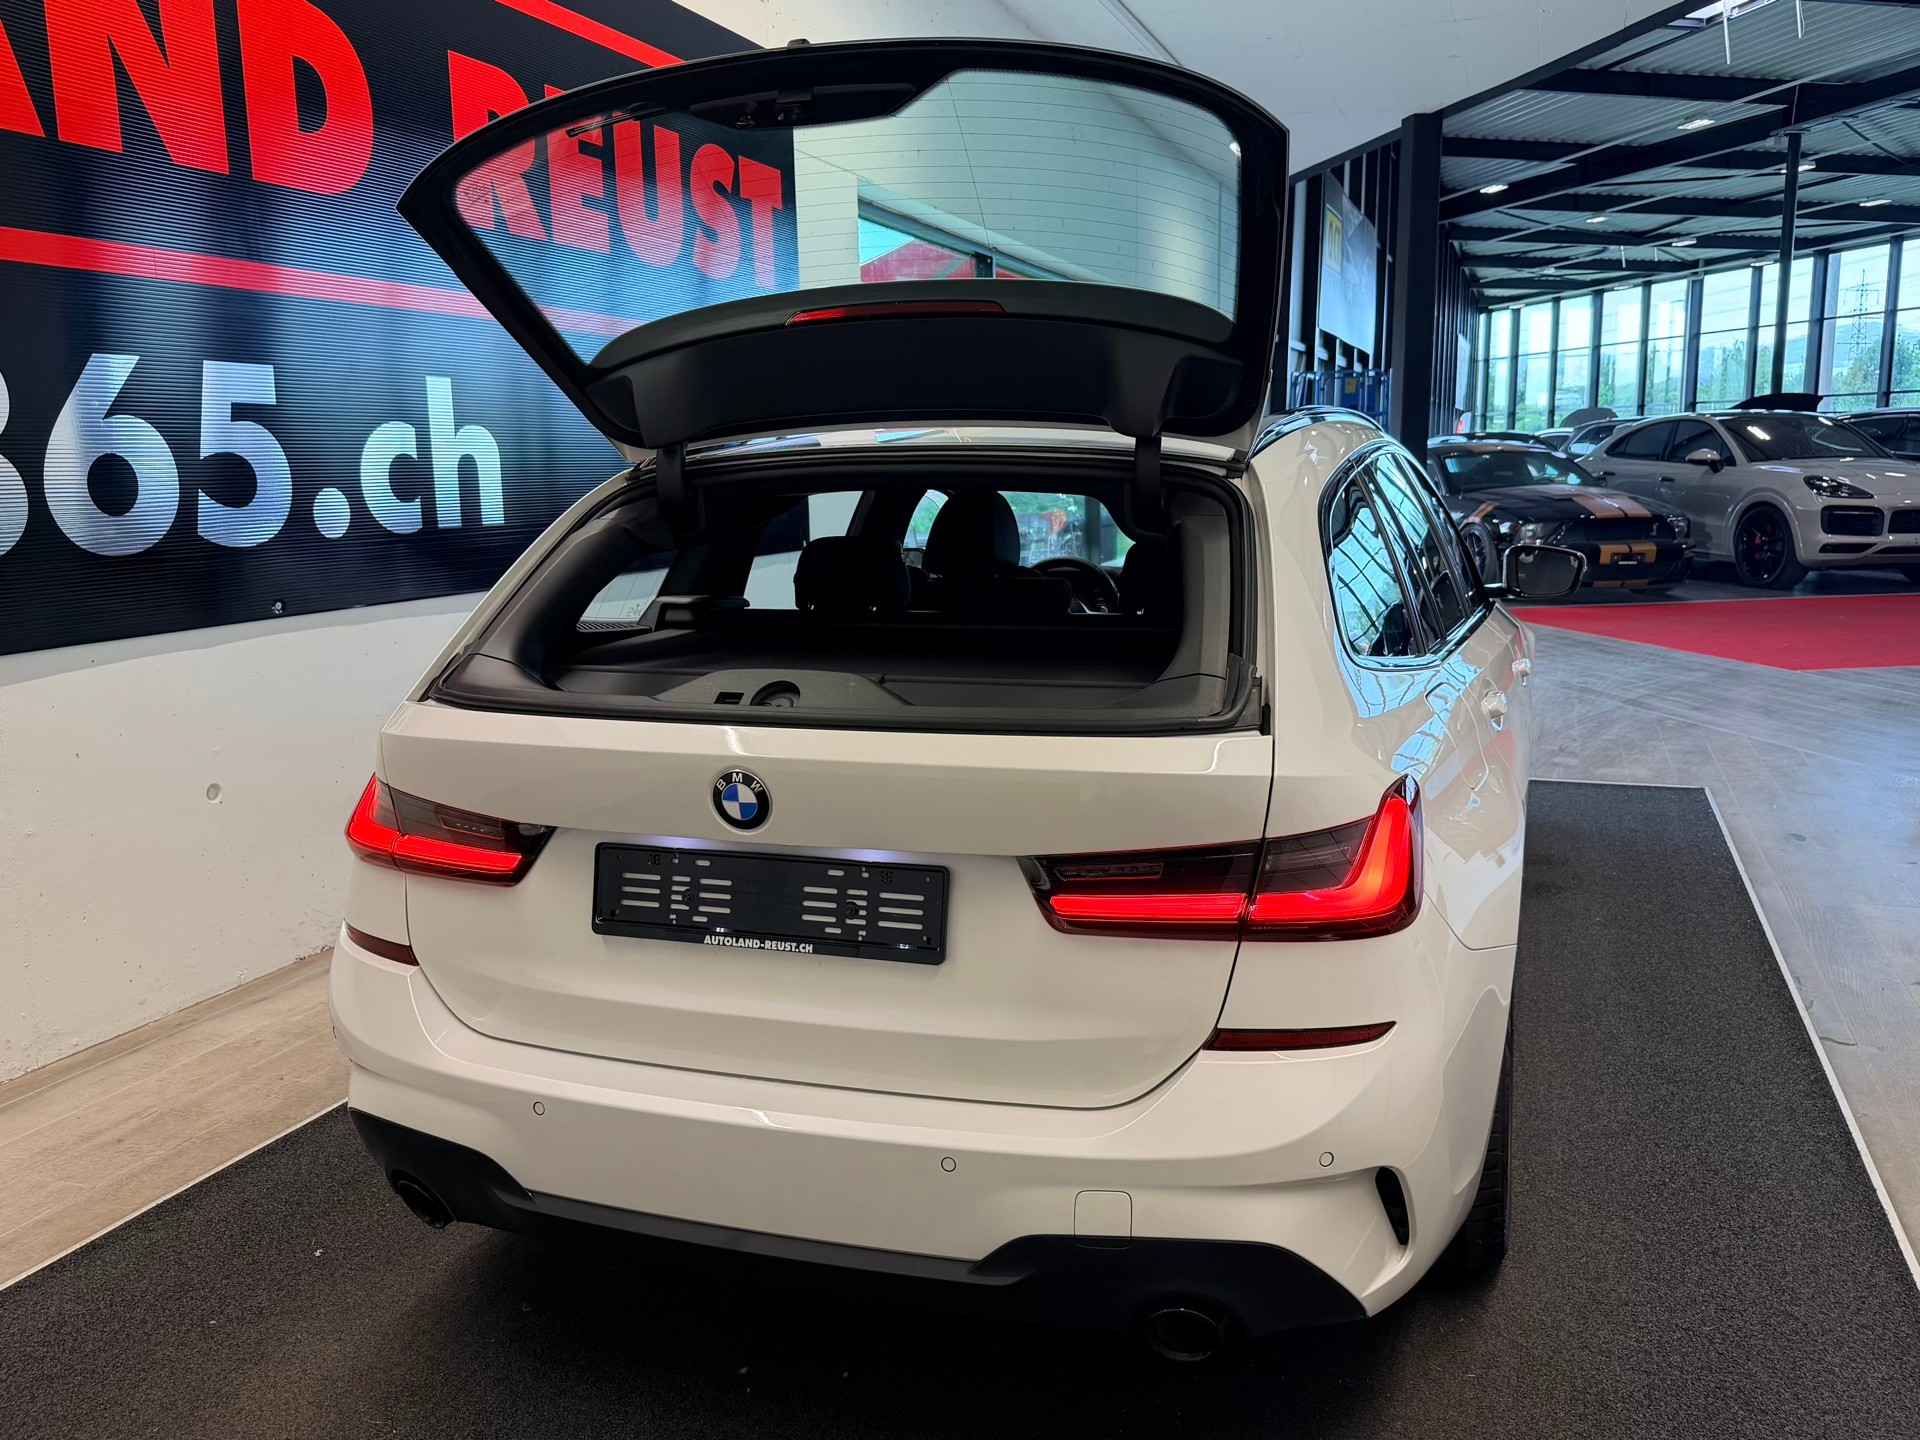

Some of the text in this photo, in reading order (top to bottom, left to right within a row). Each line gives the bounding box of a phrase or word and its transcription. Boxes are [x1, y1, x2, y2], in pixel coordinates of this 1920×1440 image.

[0, 0, 782, 290] ND REUST
[716, 772, 763, 793] BMW
[703, 934, 814, 954] AUTOLAND-REUST.CH
